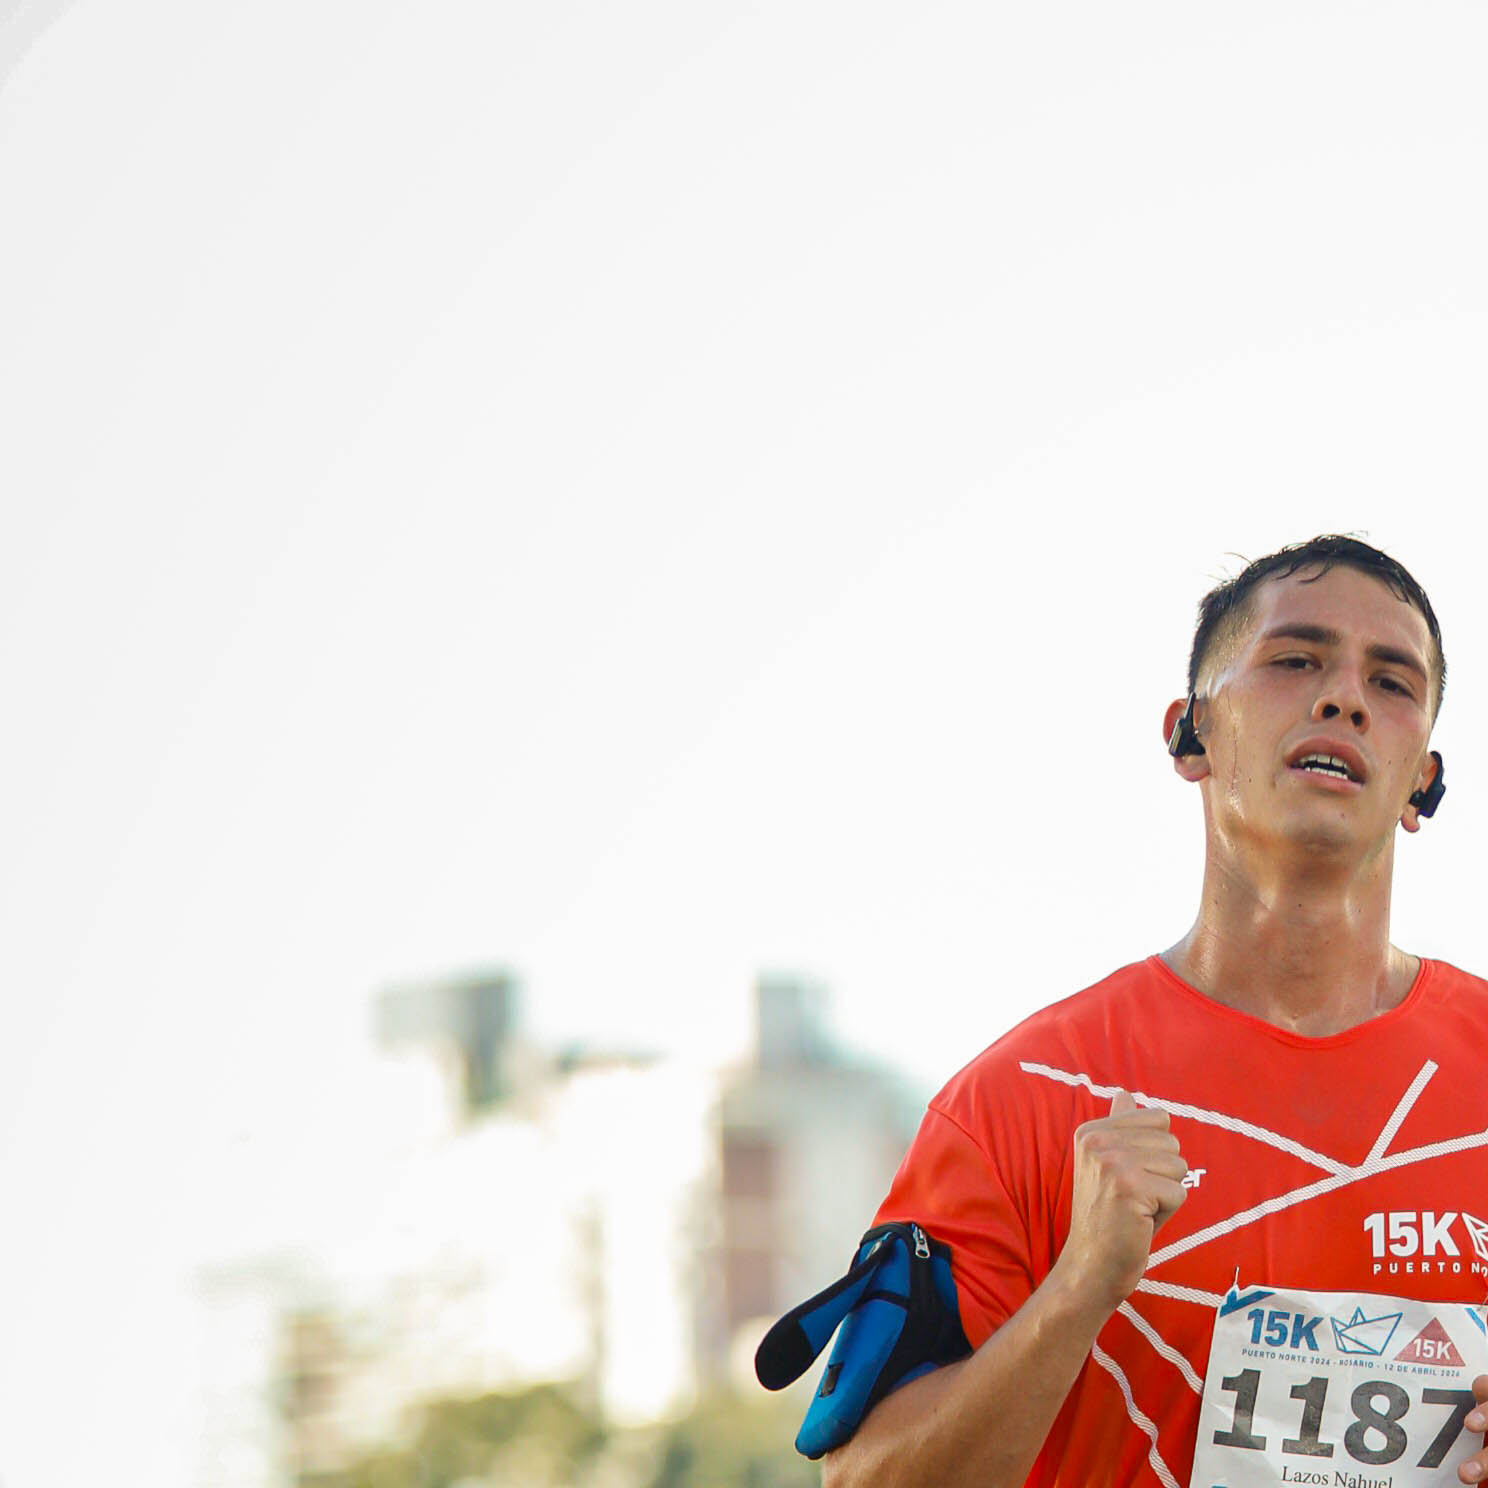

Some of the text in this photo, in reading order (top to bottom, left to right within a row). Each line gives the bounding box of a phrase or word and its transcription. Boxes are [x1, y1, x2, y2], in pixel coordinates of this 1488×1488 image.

[1363, 1211, 1460, 1257] 15K
[1372, 1262, 1461, 1275] PUERTO
[1247, 1308, 1324, 1351] 15K
[1242, 1348, 1275, 1360] PUERTO
[1278, 1353, 1307, 1364] NORTE
[1338, 1359, 1374, 1369] ROSARIO
[1384, 1363, 1394, 1371] 12
[1397, 1365, 1409, 1373] DE
[1411, 1366, 1438, 1376] ABRIL
[1412, 1338, 1453, 1360] 15K
[1213, 1368, 1477, 1469] 1187
[1281, 1466, 1329, 1487] Lazos
